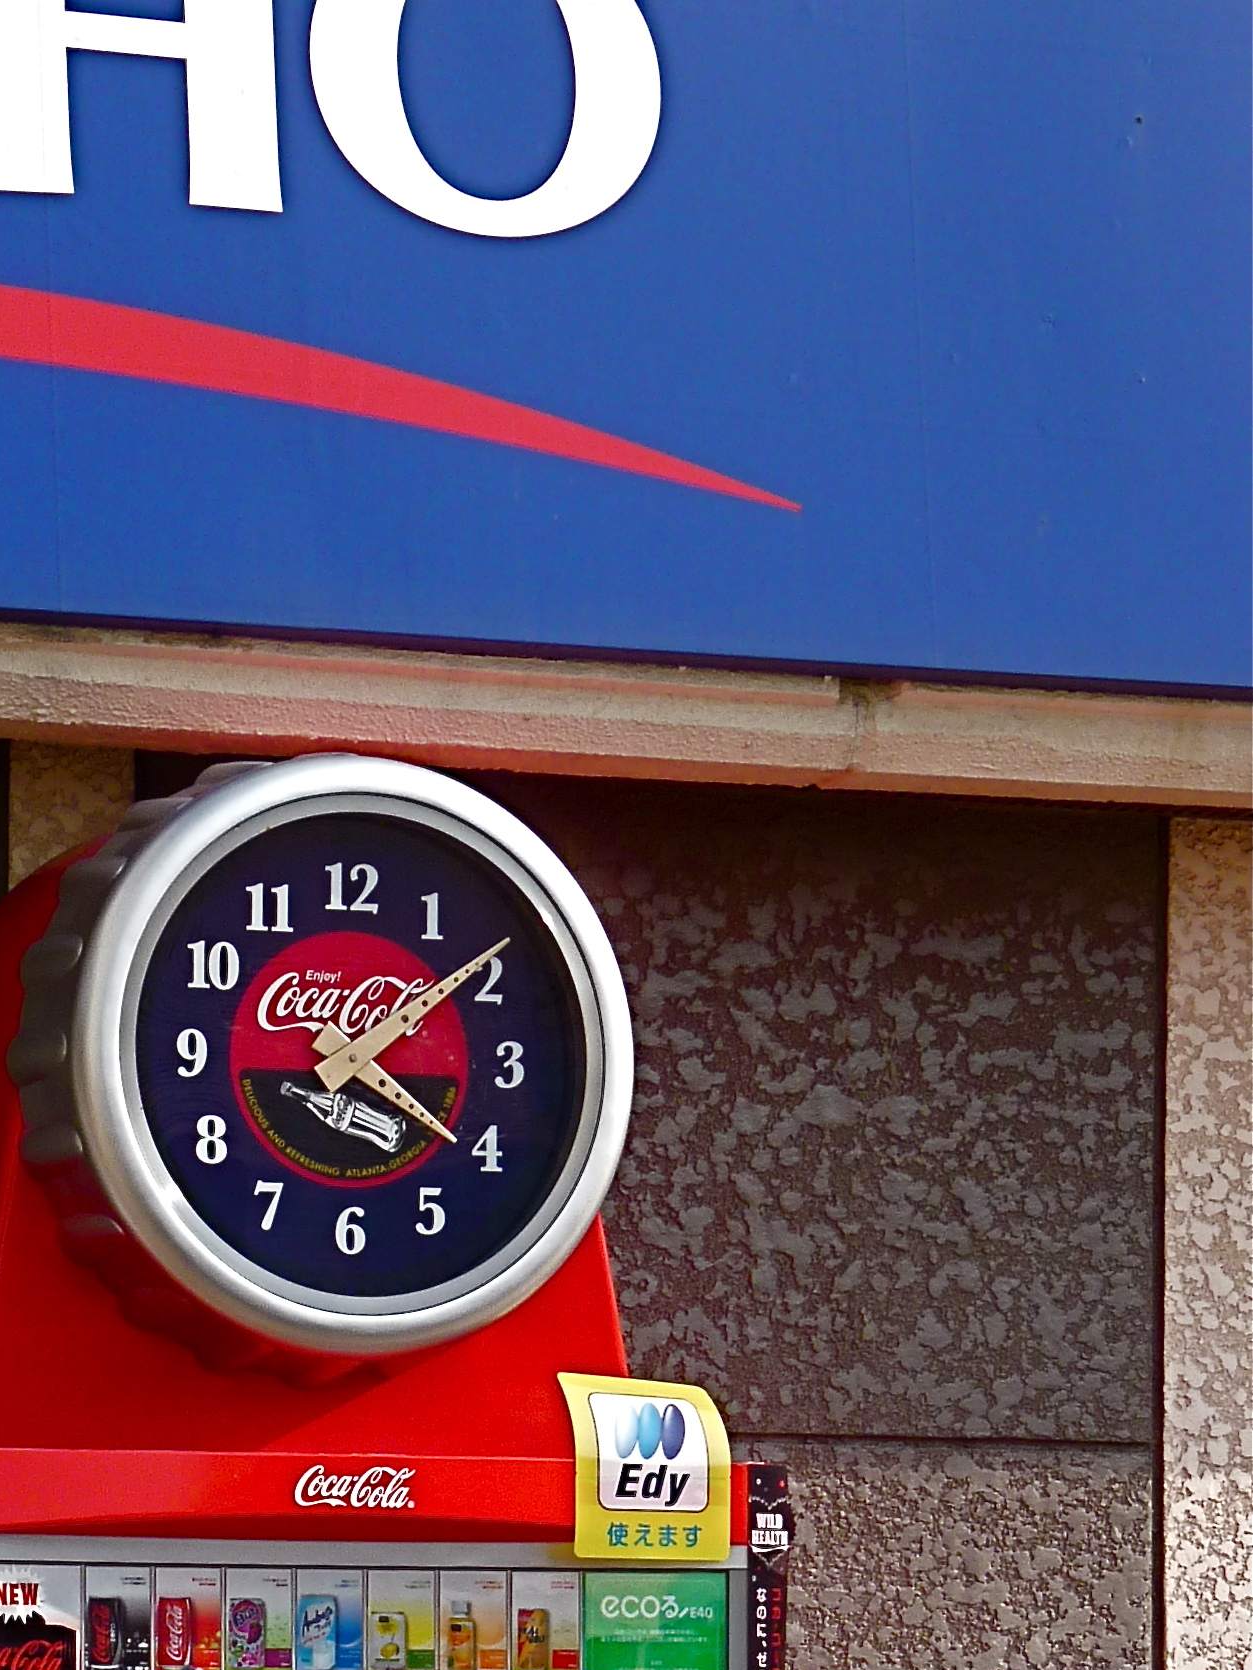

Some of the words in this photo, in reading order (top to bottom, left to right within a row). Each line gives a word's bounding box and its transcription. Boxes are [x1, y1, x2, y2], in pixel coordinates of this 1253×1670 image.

[245, 883, 294, 934] 11
[324, 862, 380, 915] 12
[421, 893, 444, 940] 1
[187, 940, 241, 991] 10
[305, 969, 342, 985] Enjoy!
[474, 956, 504, 1005] 2
[176, 1029, 208, 1078] 9
[494, 1040, 526, 1088] 3
[195, 1114, 228, 1165] 8
[242, 1077, 270, 1130] DELICIOUS
[266, 1129, 286, 1148] AND
[285, 1145, 341, 1177] REFRESHING
[471, 1125, 504, 1172] 4
[253, 1181, 284, 1231] 7
[335, 1206, 366, 1255] 6
[416, 1187, 446, 1236] 5
[294, 1464, 411, 1509] Coca-Cola
[615, 1463, 690, 1508] Edy
[606, 1522, 704, 1549] 使えます
[752, 1530, 789, 1548] HEALTH
[755, 1512, 783, 1530] WILD
